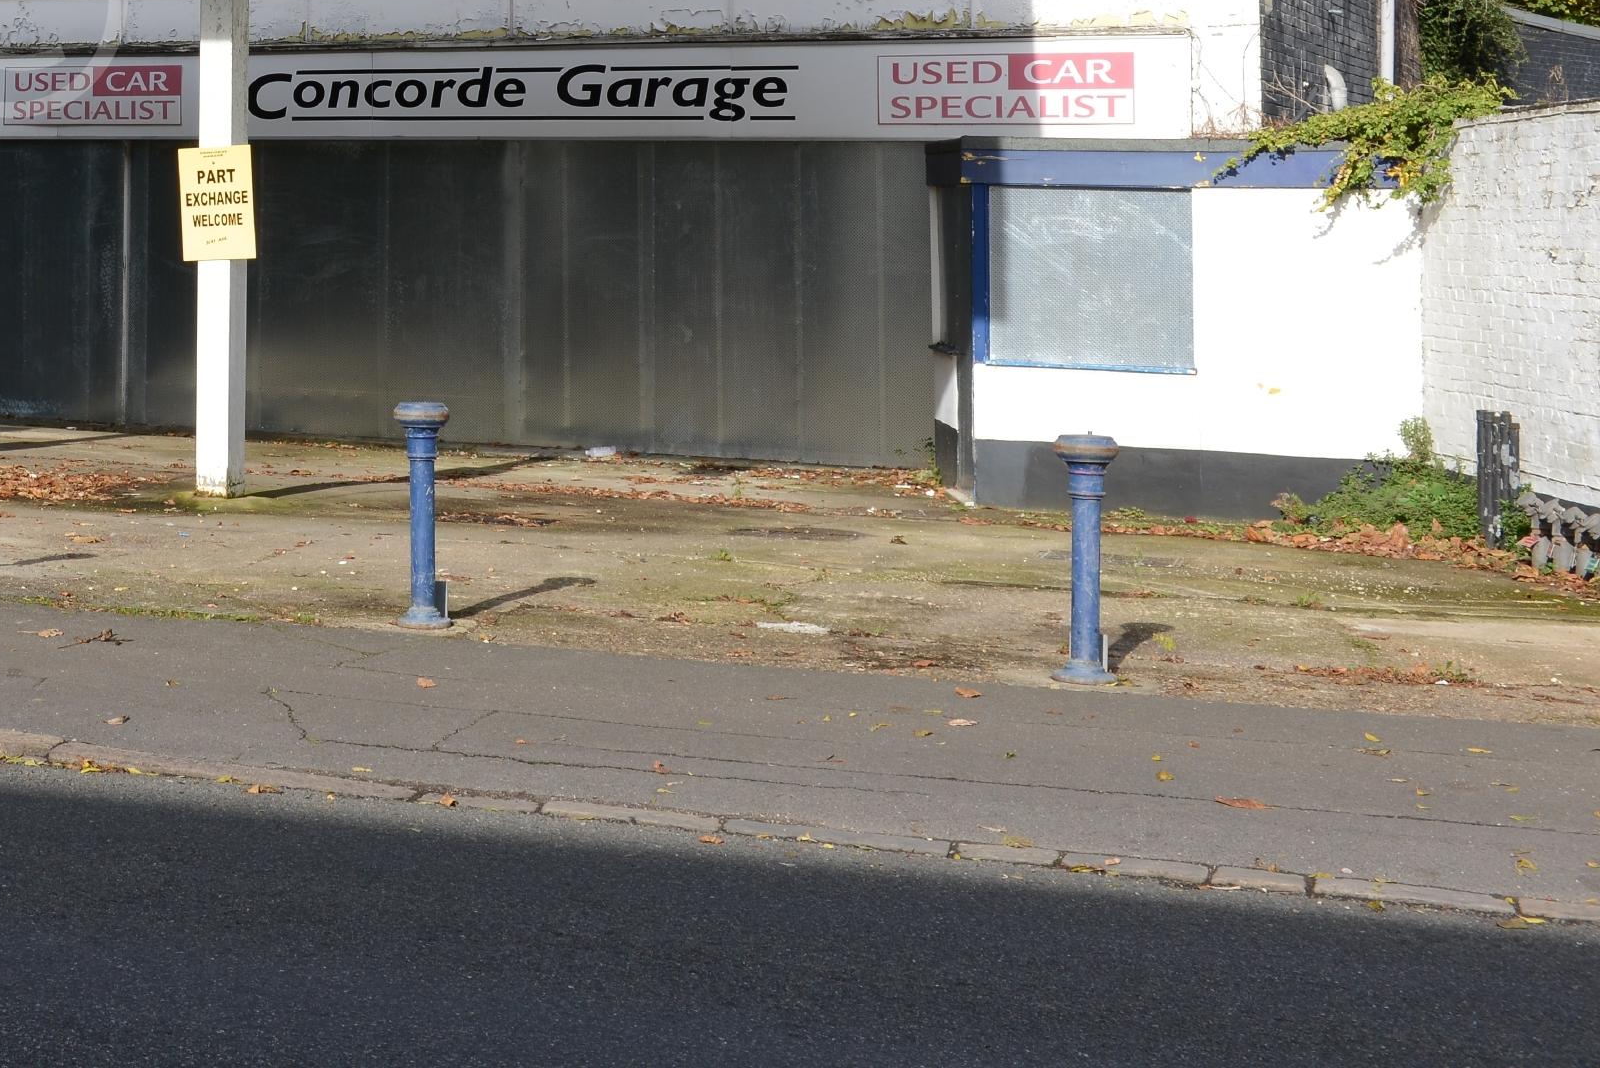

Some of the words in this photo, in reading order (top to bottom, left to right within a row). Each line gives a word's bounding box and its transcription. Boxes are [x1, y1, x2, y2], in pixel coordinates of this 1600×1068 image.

[14, 72, 91, 92] USED
[106, 71, 169, 92] CAR
[891, 60, 1003, 85] USED
[1023, 59, 1116, 85] CAR
[248, 66, 527, 120] Concorde
[556, 64, 788, 122] Garage
[12, 100, 176, 120] SPECIALIST
[890, 94, 1127, 119] SPECIALIST
[197, 168, 235, 184] PART
[185, 190, 248, 207] EXCHANGE
[192, 213, 243, 227] WELCOME
